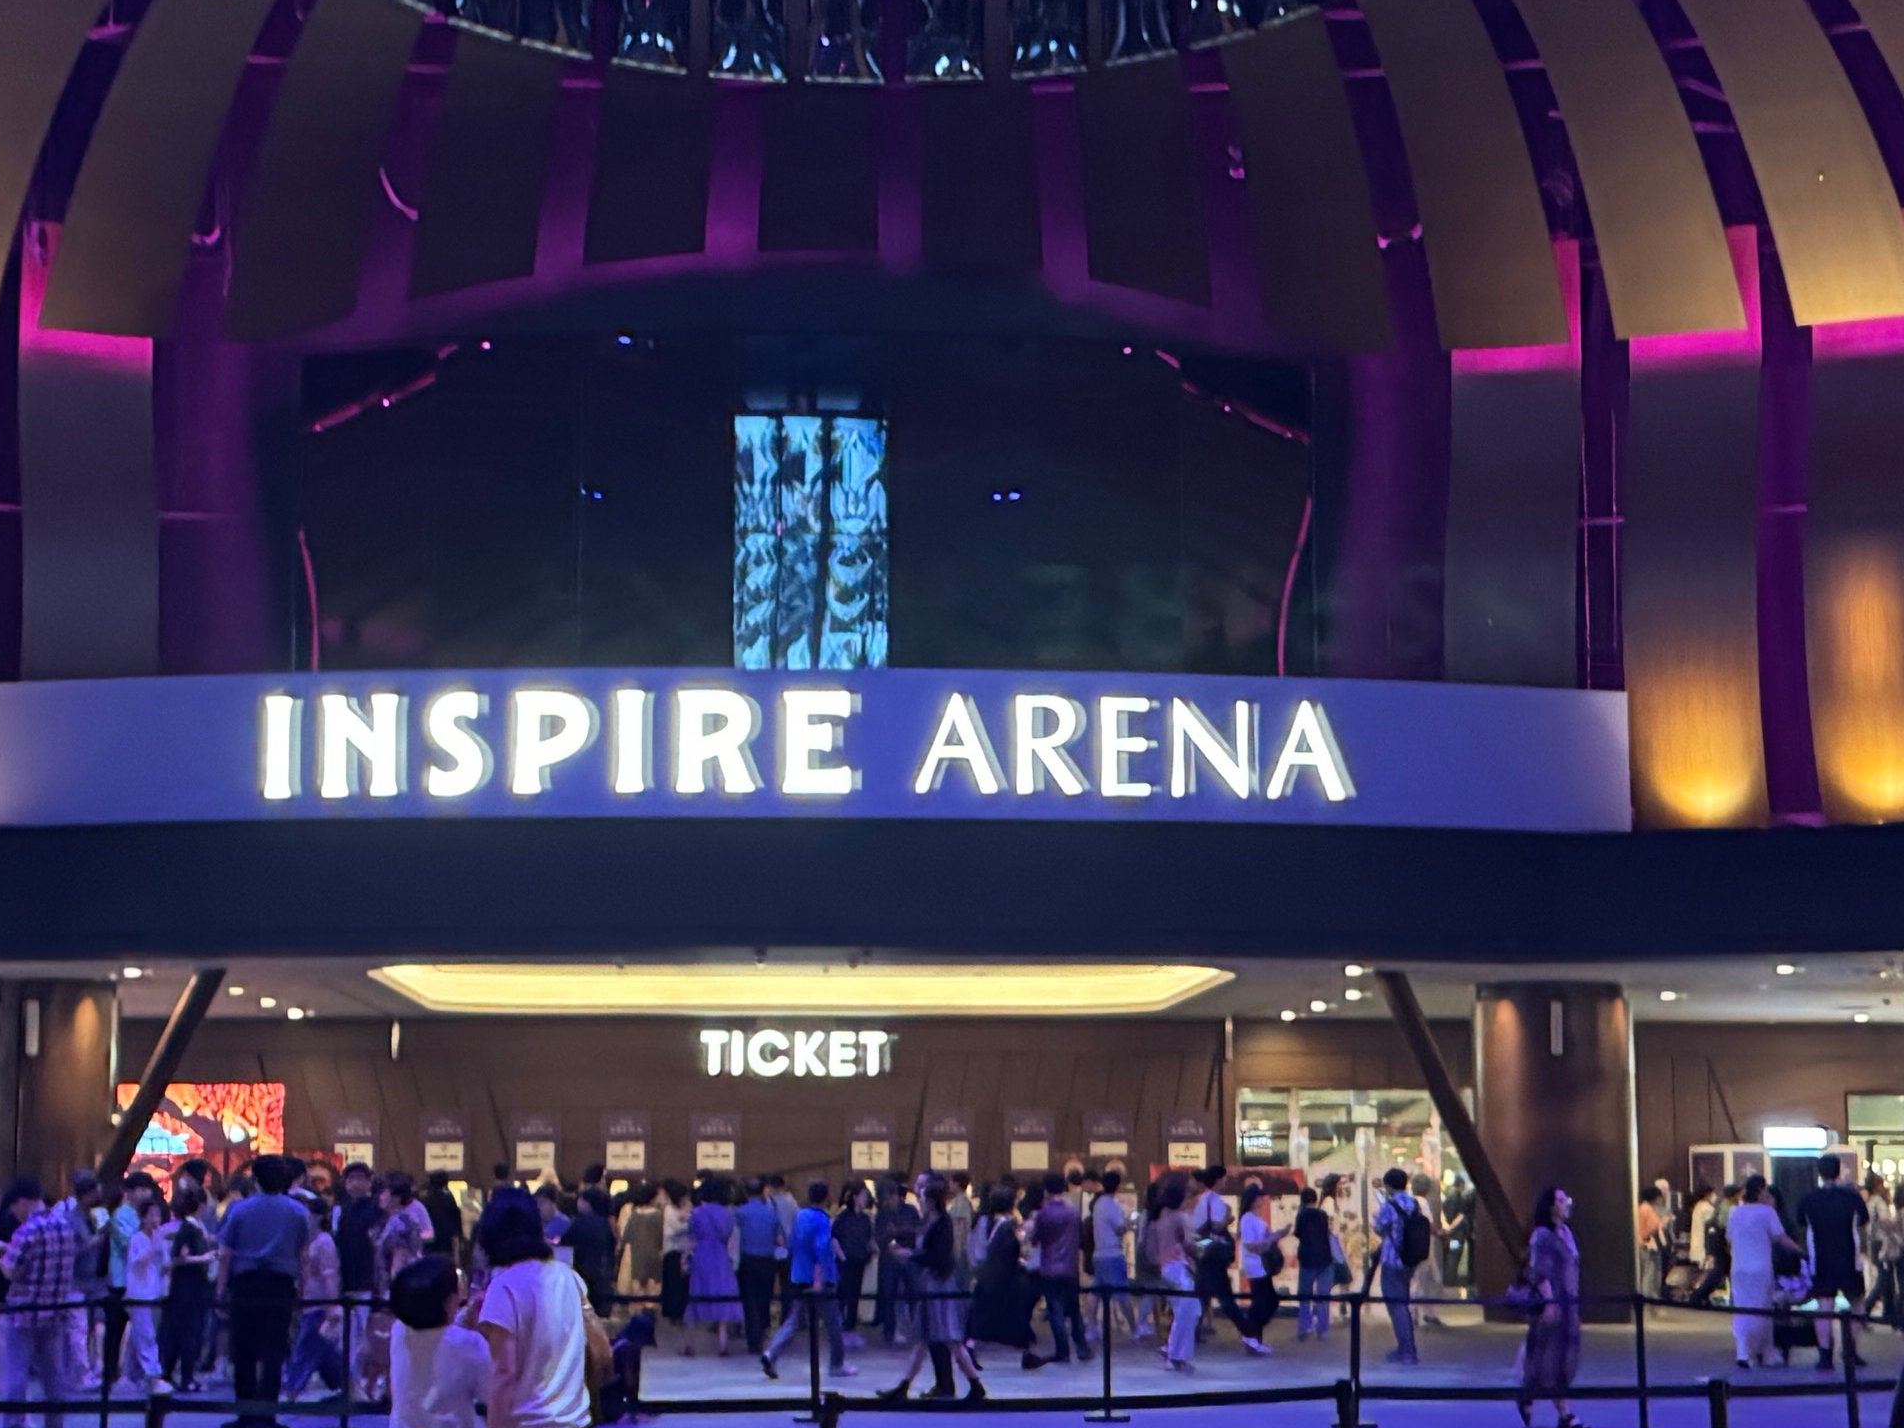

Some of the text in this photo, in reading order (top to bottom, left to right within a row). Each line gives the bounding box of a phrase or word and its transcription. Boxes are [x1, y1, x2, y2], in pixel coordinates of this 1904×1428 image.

[261, 688, 1348, 802] INSPIRE ARENA
[699, 1028, 889, 1078] TICKET
